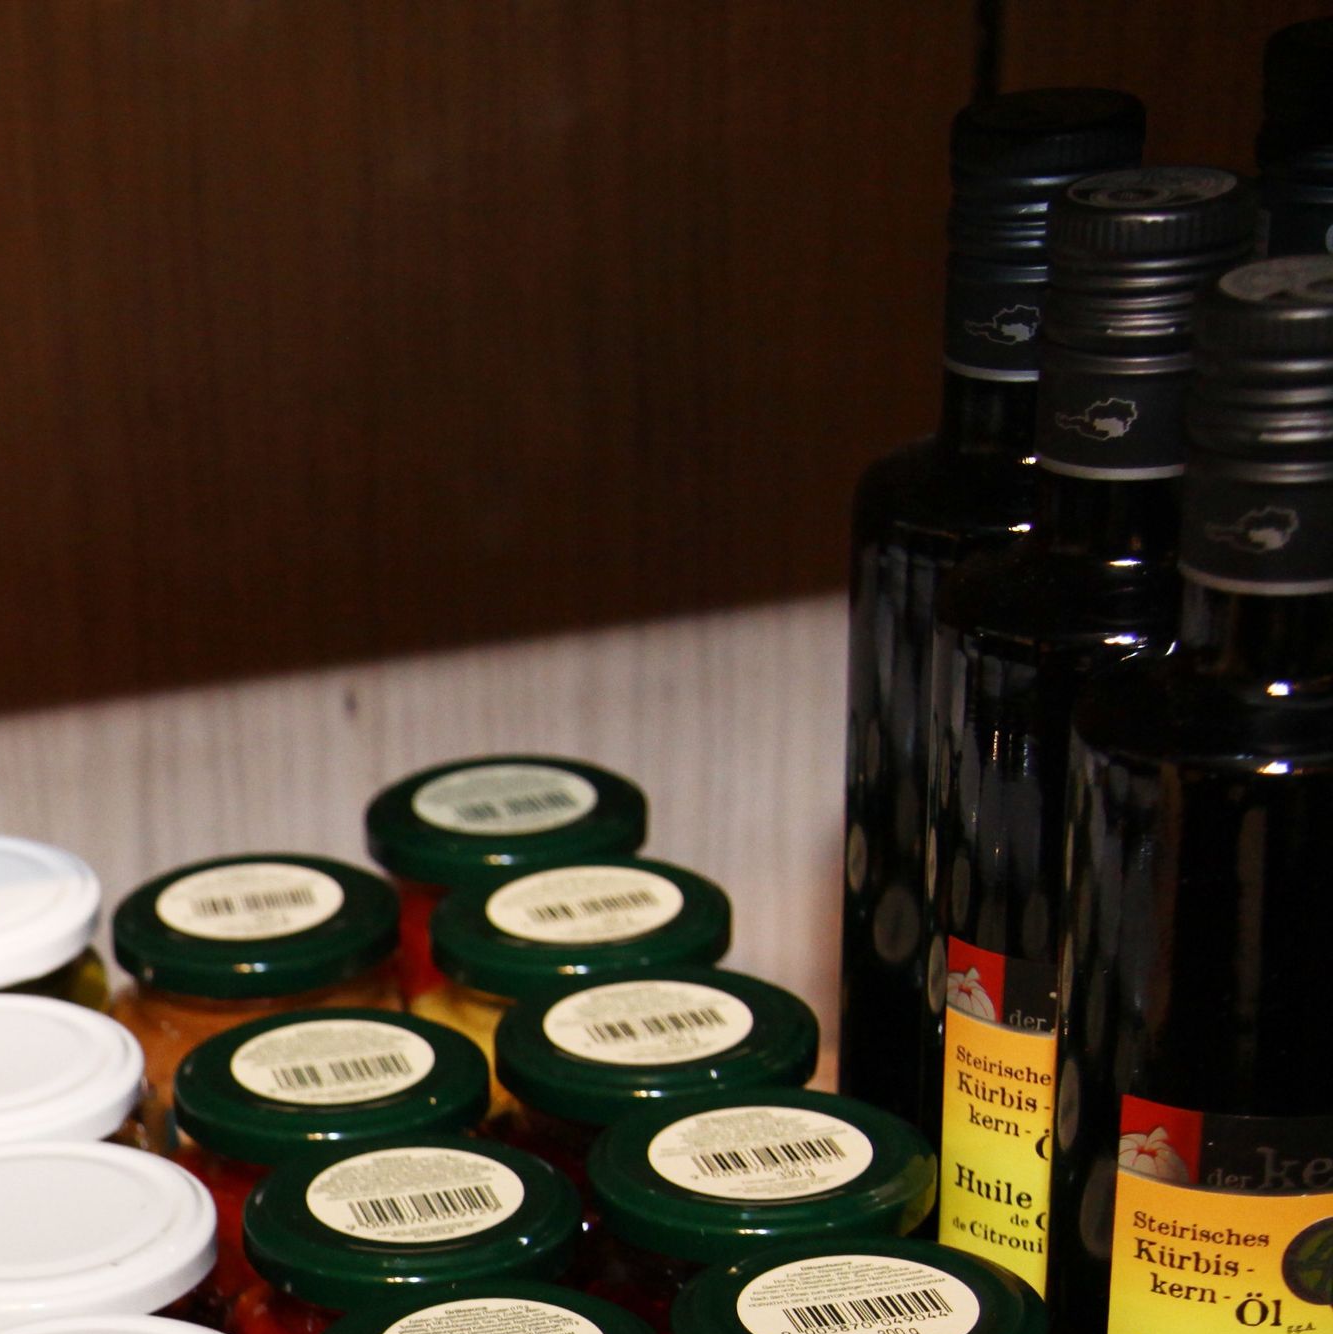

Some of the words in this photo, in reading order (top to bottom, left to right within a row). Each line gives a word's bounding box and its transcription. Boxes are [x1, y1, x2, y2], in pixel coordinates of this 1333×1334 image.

[1009, 1009, 1047, 1032] der
[955, 1162, 1033, 1211] Huile
[1207, 1166, 1255, 1190] der
[952, 1216, 967, 1232] de
[1010, 1213, 1030, 1229] de
[1133, 1210, 1271, 1248] Steirisches
[880, 1310, 949, 1327] 049044
[1235, 1291, 1283, 1327] Öl
